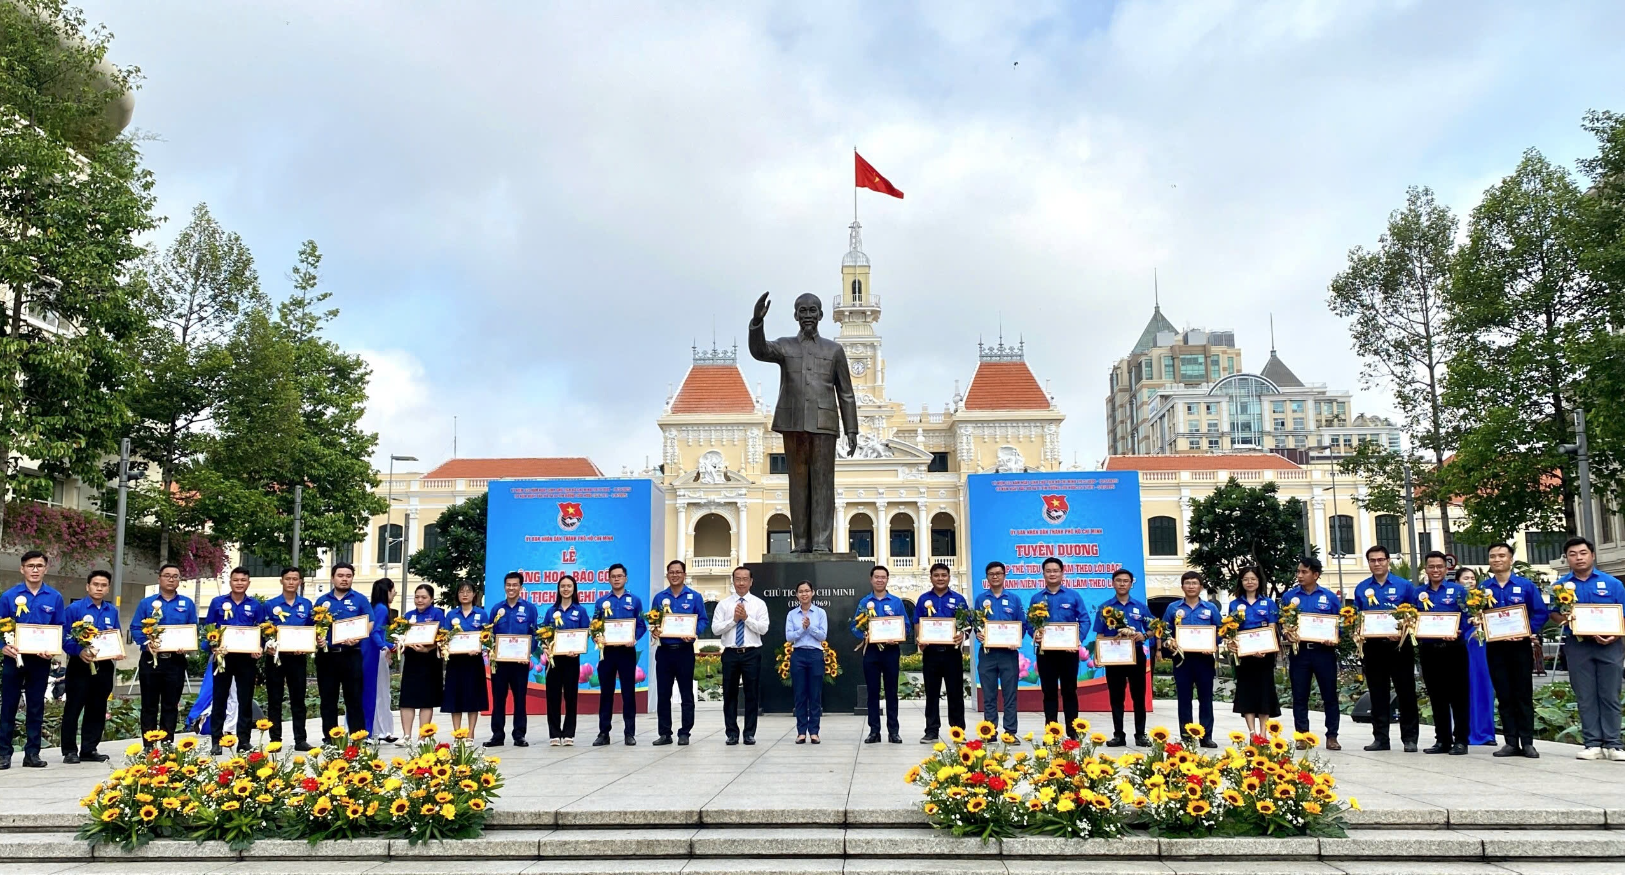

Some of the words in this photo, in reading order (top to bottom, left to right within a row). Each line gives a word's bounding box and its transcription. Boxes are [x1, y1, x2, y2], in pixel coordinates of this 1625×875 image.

[562, 546, 576, 564] LỄ
[1016, 542, 1054, 557] TUYÊN
[1058, 544, 1099, 556] DƯƠNG
[572, 567, 594, 583] BÁO
[1012, 561, 1024, 574] THỂ
[1075, 563, 1092, 574] THEO
[1094, 561, 1105, 573] LỜI
[1020, 577, 1036, 589] NIÊN
[1072, 577, 1087, 588] LÀM
[1088, 578, 1106, 588] THEO
[531, 590, 556, 606] TỊCH
[578, 587, 597, 603] CHÍ
[764, 588, 780, 597] CHỦ
[782, 589, 797, 597] TỊC
[816, 587, 830, 596] CHÍ
